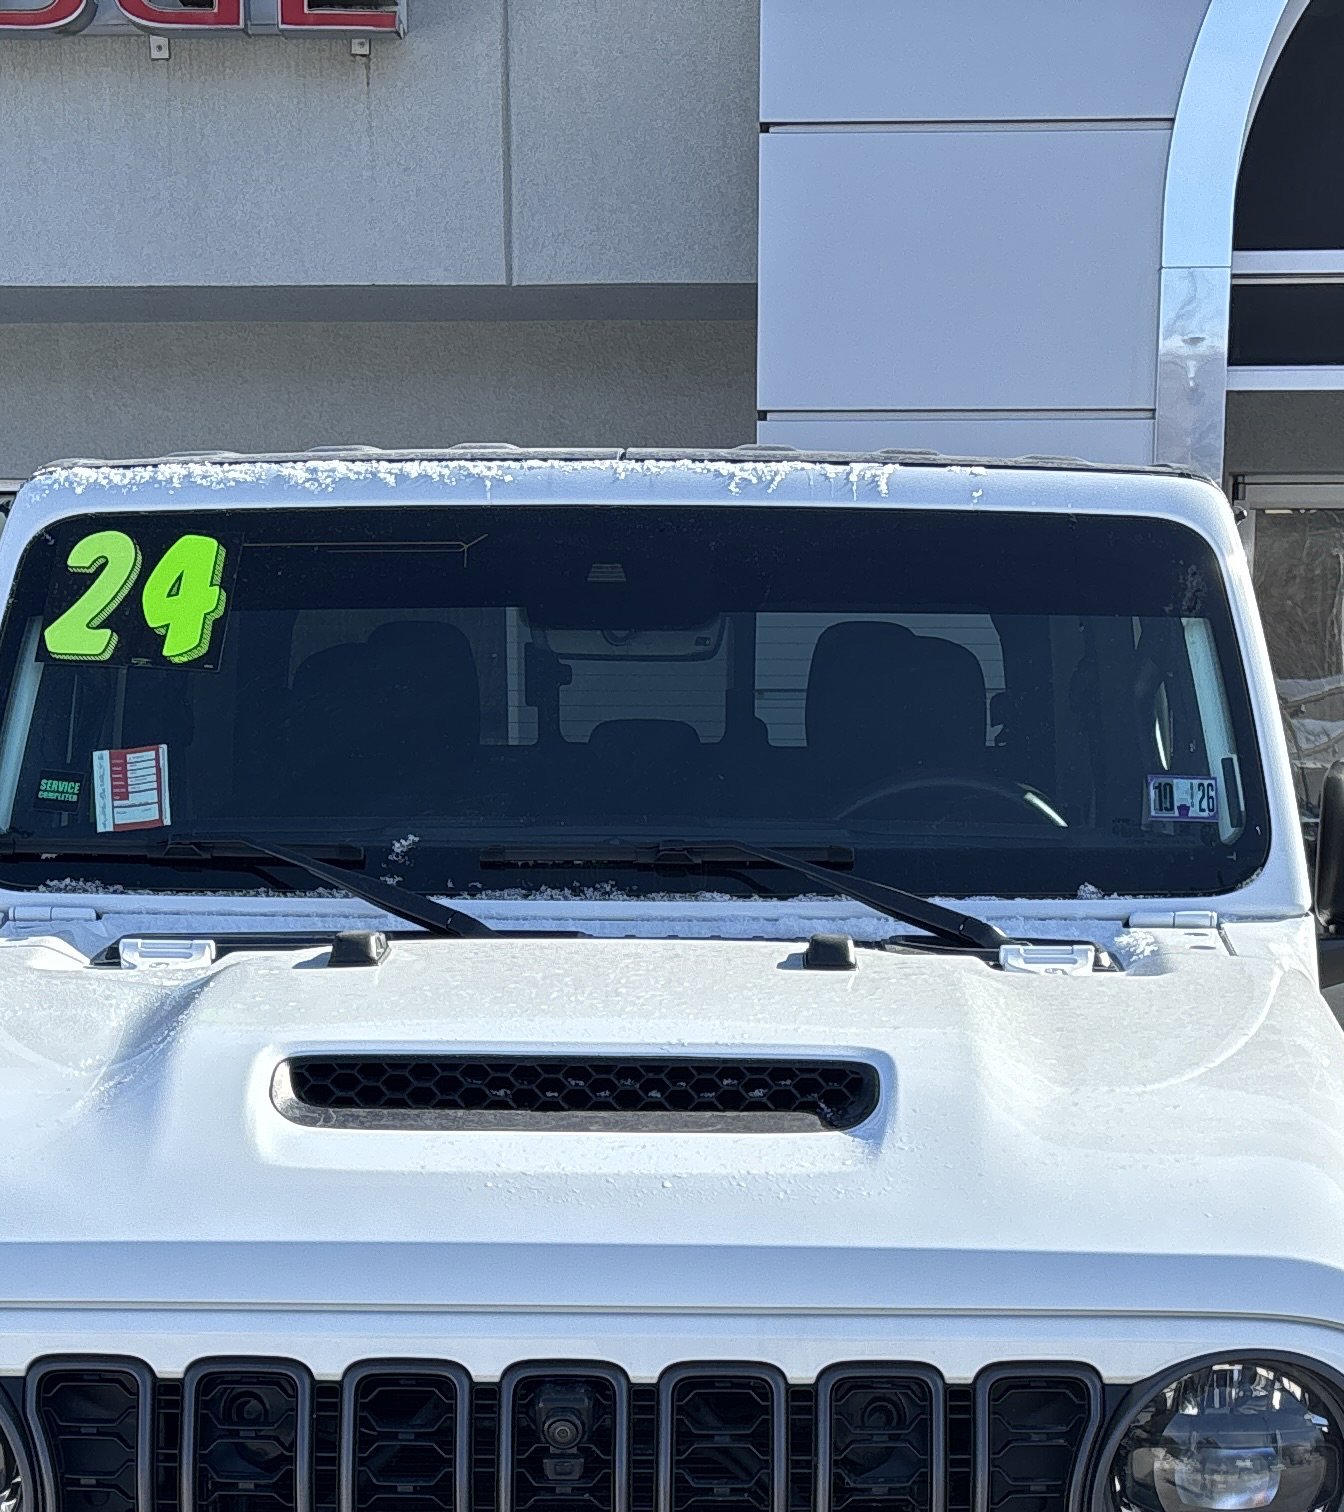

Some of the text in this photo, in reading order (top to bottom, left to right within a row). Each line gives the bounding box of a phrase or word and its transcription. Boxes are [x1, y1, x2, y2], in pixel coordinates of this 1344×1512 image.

[44, 530, 227, 664] 24
[39, 779, 81, 794] SERVICE
[1197, 782, 1215, 812] 26
